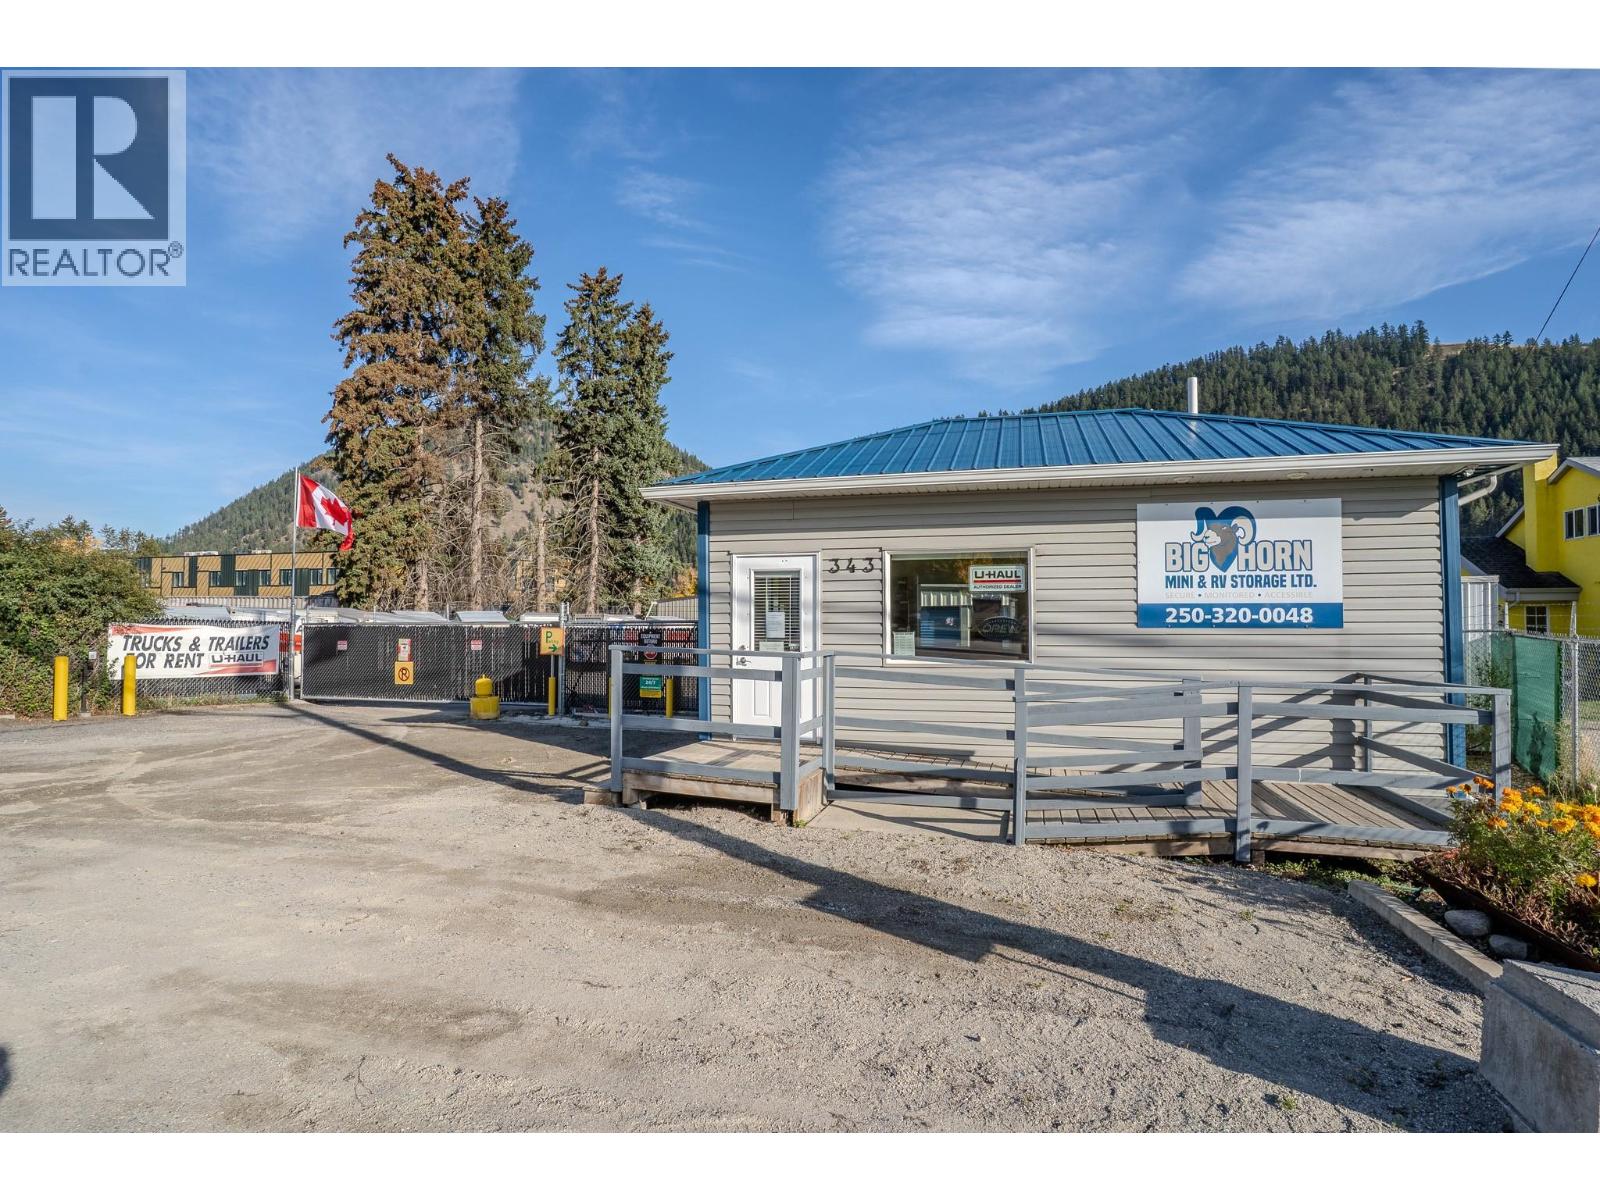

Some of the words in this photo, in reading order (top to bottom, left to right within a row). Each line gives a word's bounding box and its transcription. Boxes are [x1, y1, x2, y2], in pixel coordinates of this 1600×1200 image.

[1165, 541, 1210, 573] BIG
[1237, 540, 1313, 572] HORN
[828, 557, 874, 573] 343
[974, 570, 1021, 579] U-HAUL
[1165, 574, 1193, 589] MINI
[1197, 574, 1207, 589] &
[1211, 574, 1227, 589] RV
[1231, 573, 1287, 589] STORAGE
[1291, 573, 1317, 588] LTD.
[1165, 591, 1195, 599] SECURE
[1203, 591, 1255, 599] MONITORED
[1264, 591, 1313, 599] ACCESSIBLE
[1165, 607, 1314, 624] 250-320-0048
[122, 634, 183, 652] TRUCKS
[189, 635, 201, 652] &
[208, 634, 270, 652] TRAILERS
[126, 652, 155, 669] OR
[164, 652, 205, 669] RENT
[211, 652, 263, 664] U-HAUL
